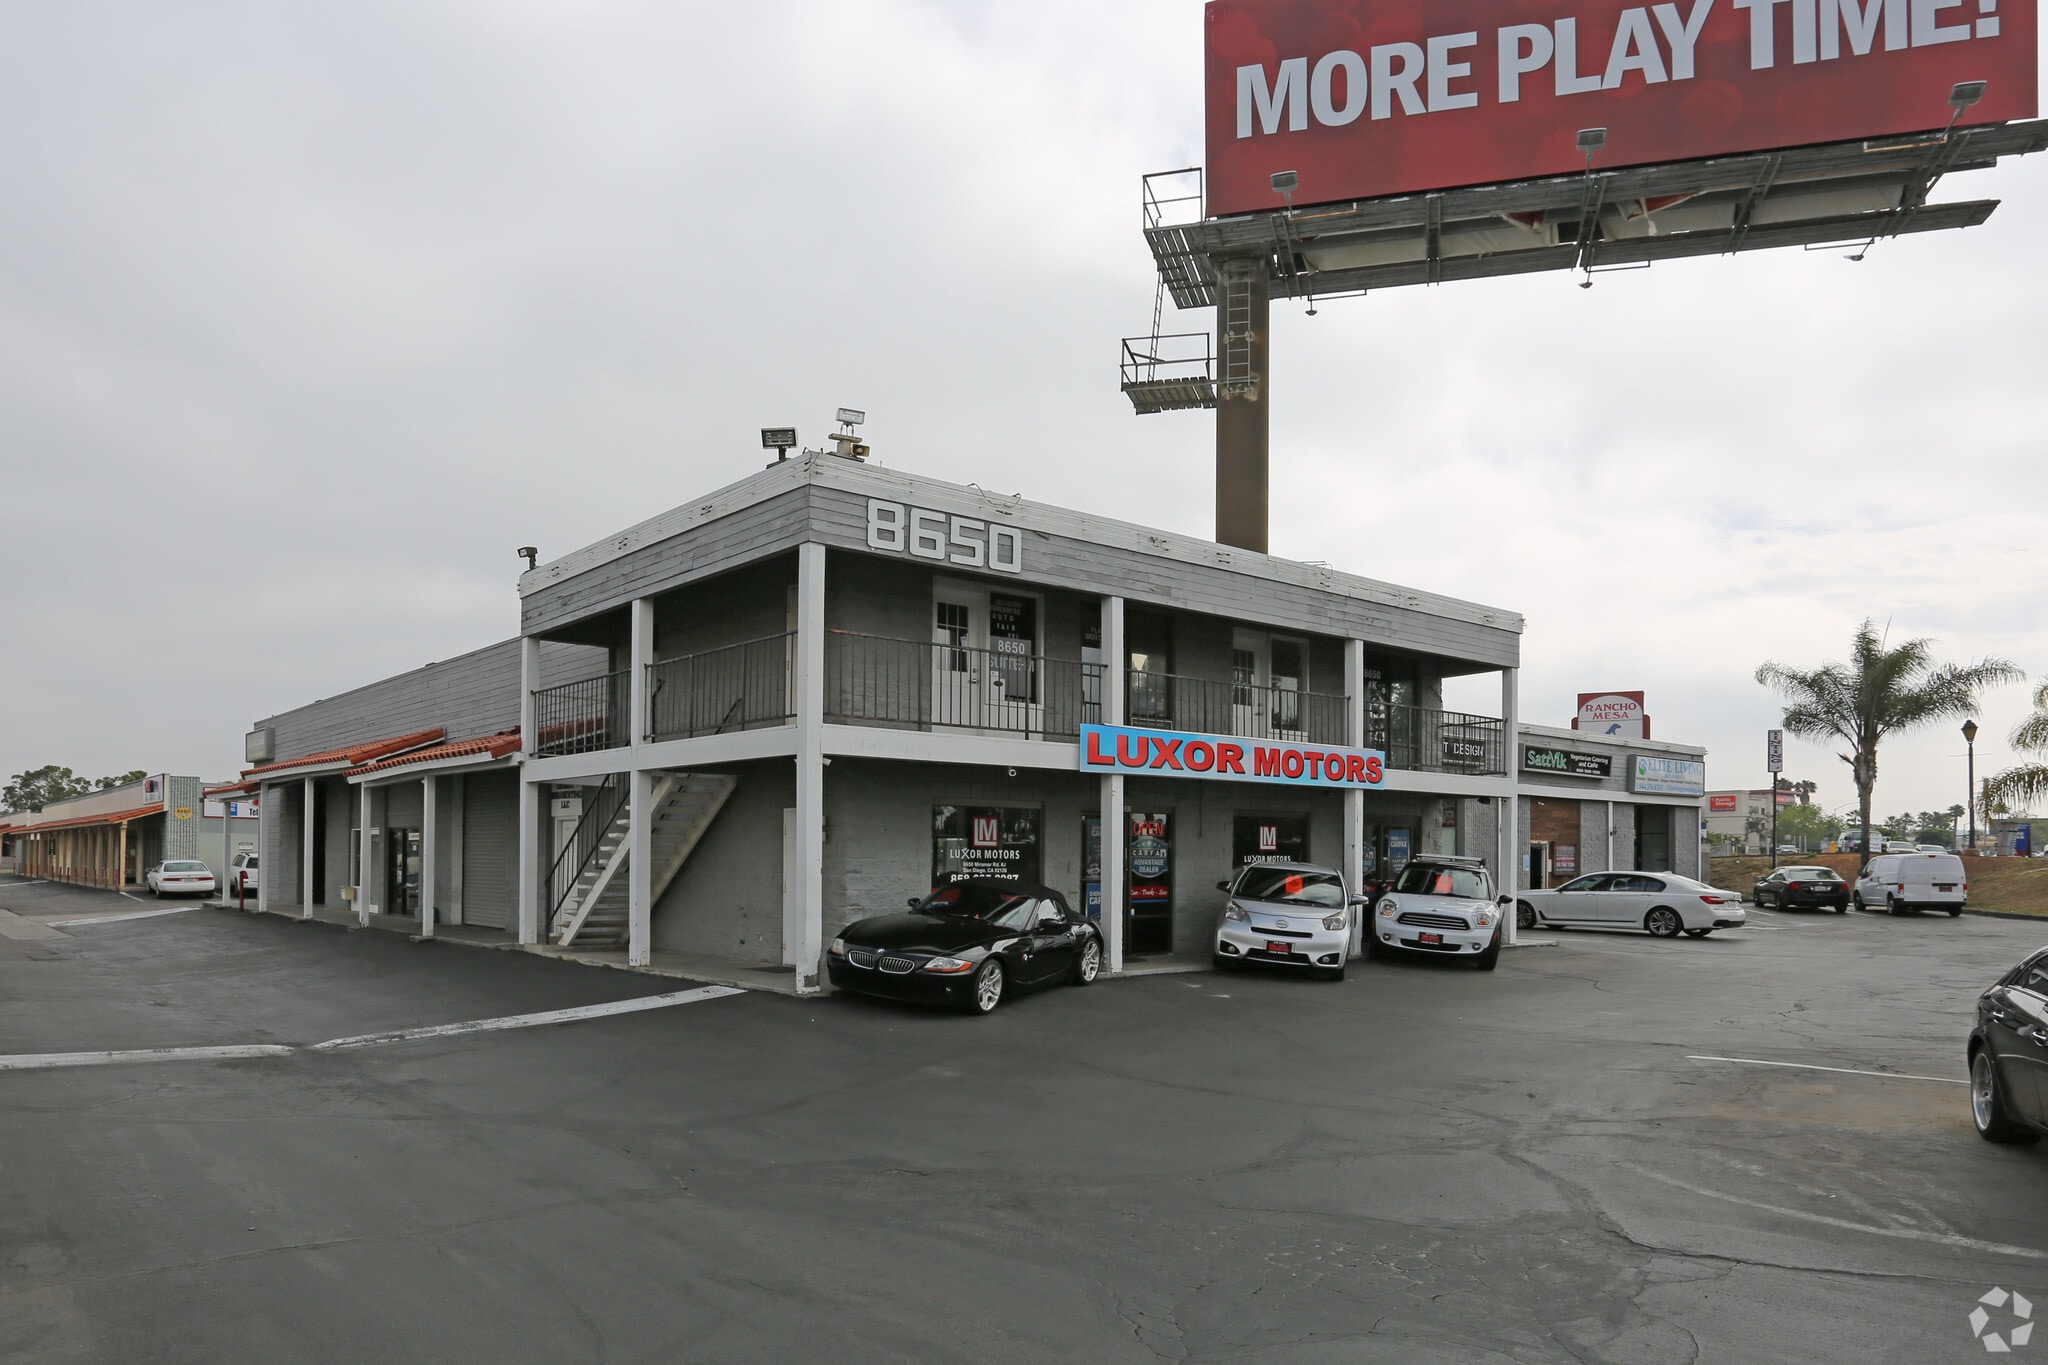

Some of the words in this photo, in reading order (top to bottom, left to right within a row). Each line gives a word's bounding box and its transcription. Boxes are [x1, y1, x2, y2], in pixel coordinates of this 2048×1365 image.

[1237, 31, 1478, 139] MORE
[1498, 0, 1714, 103] PLAY
[868, 498, 1022, 574] 8650
[998, 640, 1025, 654] 8650
[1585, 702, 1637, 713] RANCHO
[1592, 711, 1629, 720] MESA
[1453, 742, 1484, 757] DESIGN
[1087, 731, 1246, 775] LUXOR
[1254, 747, 1384, 784] MOTORS
[1648, 758, 1671, 773] ELITE
[1675, 761, 1702, 776] LIVING
[560, 800, 570, 809] LLC
[1132, 821, 1164, 836] OPEN
[949, 847, 982, 860] LUXOR
[984, 850, 1021, 860] MOTORS
[1132, 848, 1167, 858] CARFAX
[1243, 854, 1266, 864] LUXOR
[1266, 855, 1291, 863] MOTORS
[1133, 859, 1165, 867] ADVANTAGE
